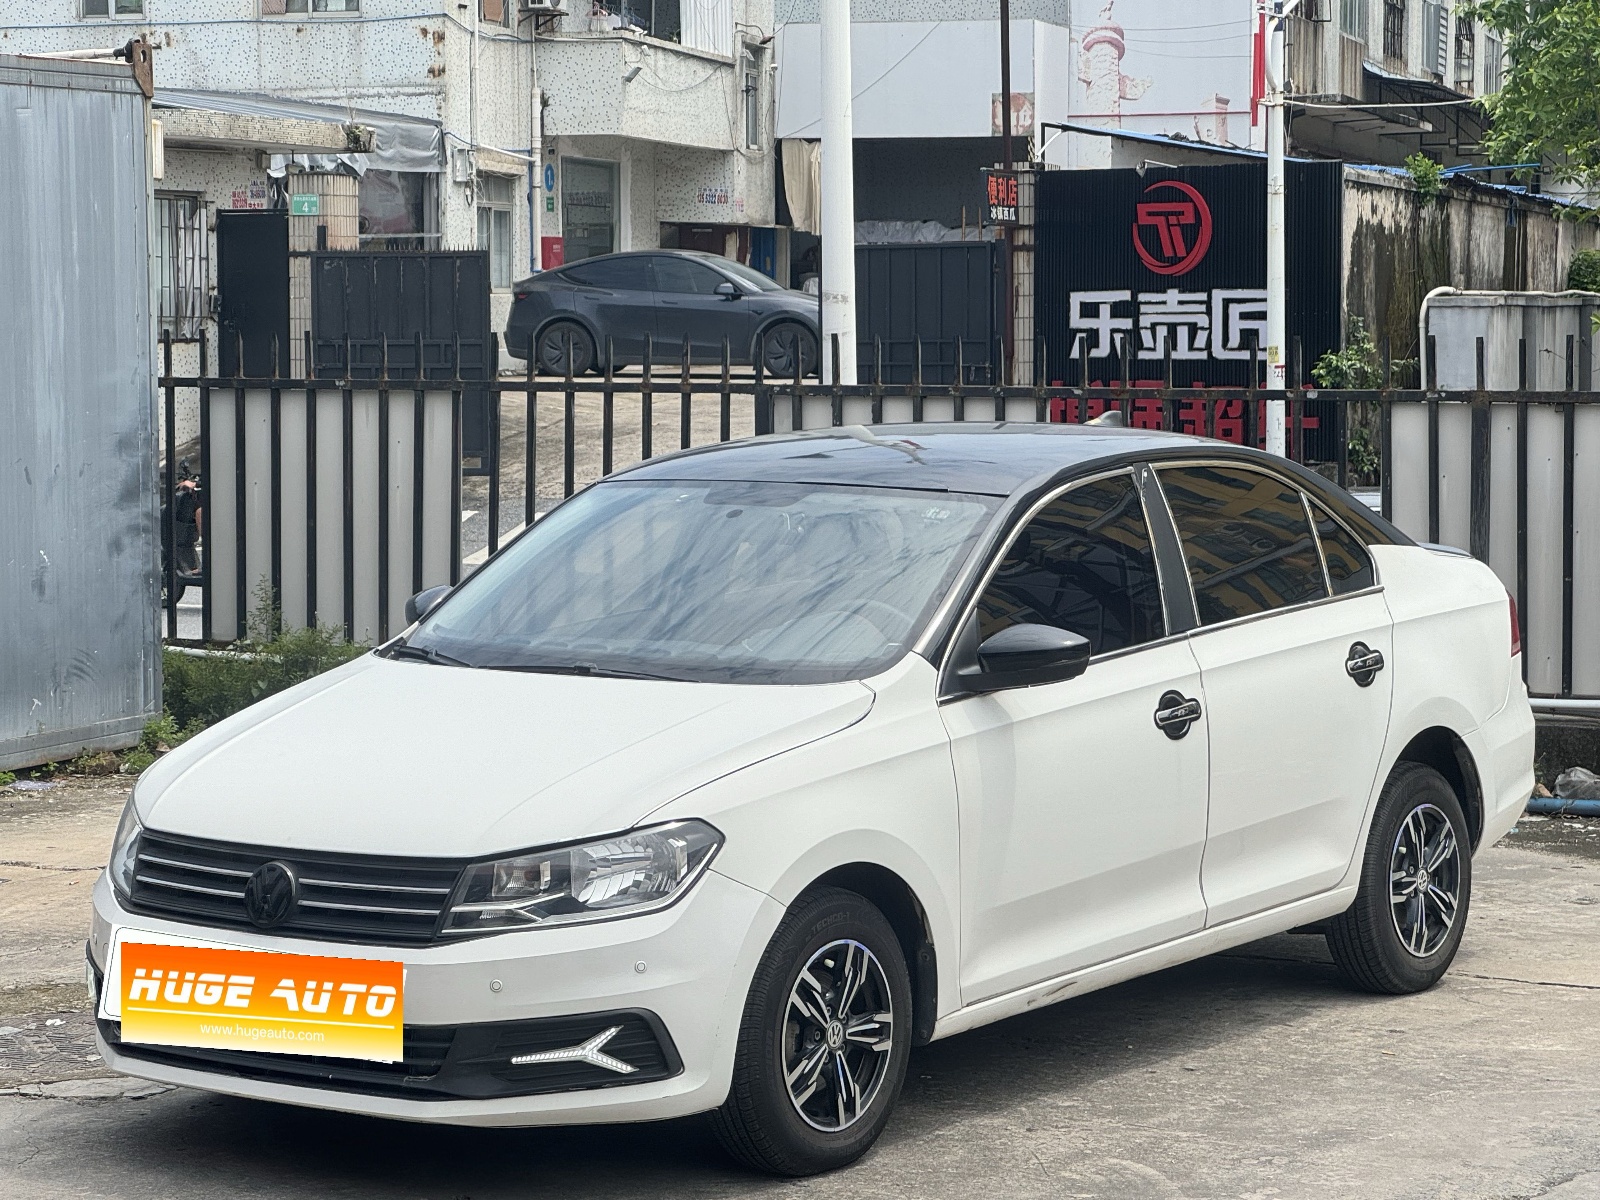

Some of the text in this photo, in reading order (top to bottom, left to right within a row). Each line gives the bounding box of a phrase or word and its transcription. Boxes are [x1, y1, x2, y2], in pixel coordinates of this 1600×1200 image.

[988, 175, 1018, 206] 便利店
[302, 202, 309, 213] 4
